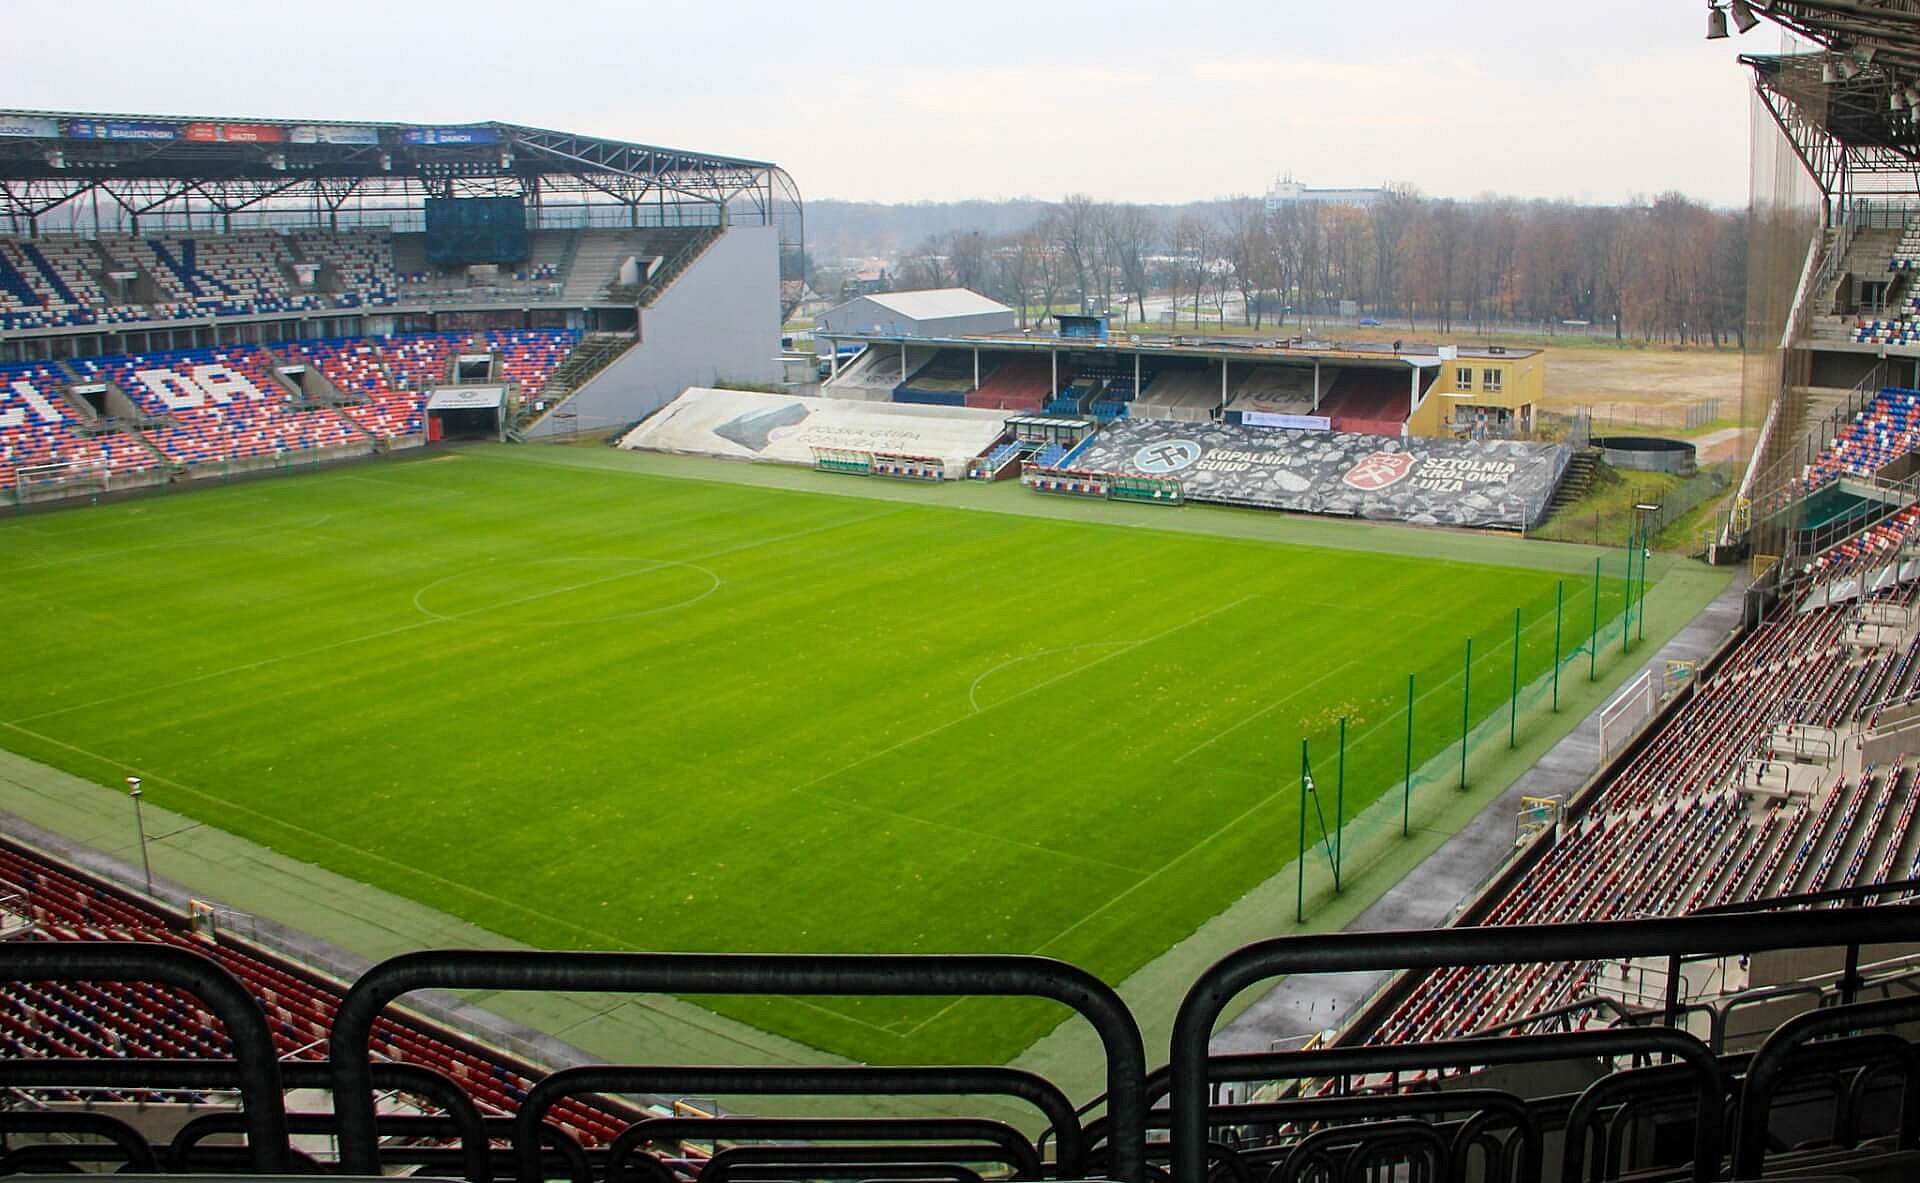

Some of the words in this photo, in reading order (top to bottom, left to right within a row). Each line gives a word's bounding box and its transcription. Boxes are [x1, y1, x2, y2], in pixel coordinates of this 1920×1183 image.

[1205, 448, 1292, 465] KOPALNIA
[1196, 459, 1252, 472] GUIDO
[1423, 457, 1516, 473] SZTOLNIA
[1408, 477, 1464, 492] LUIZA
